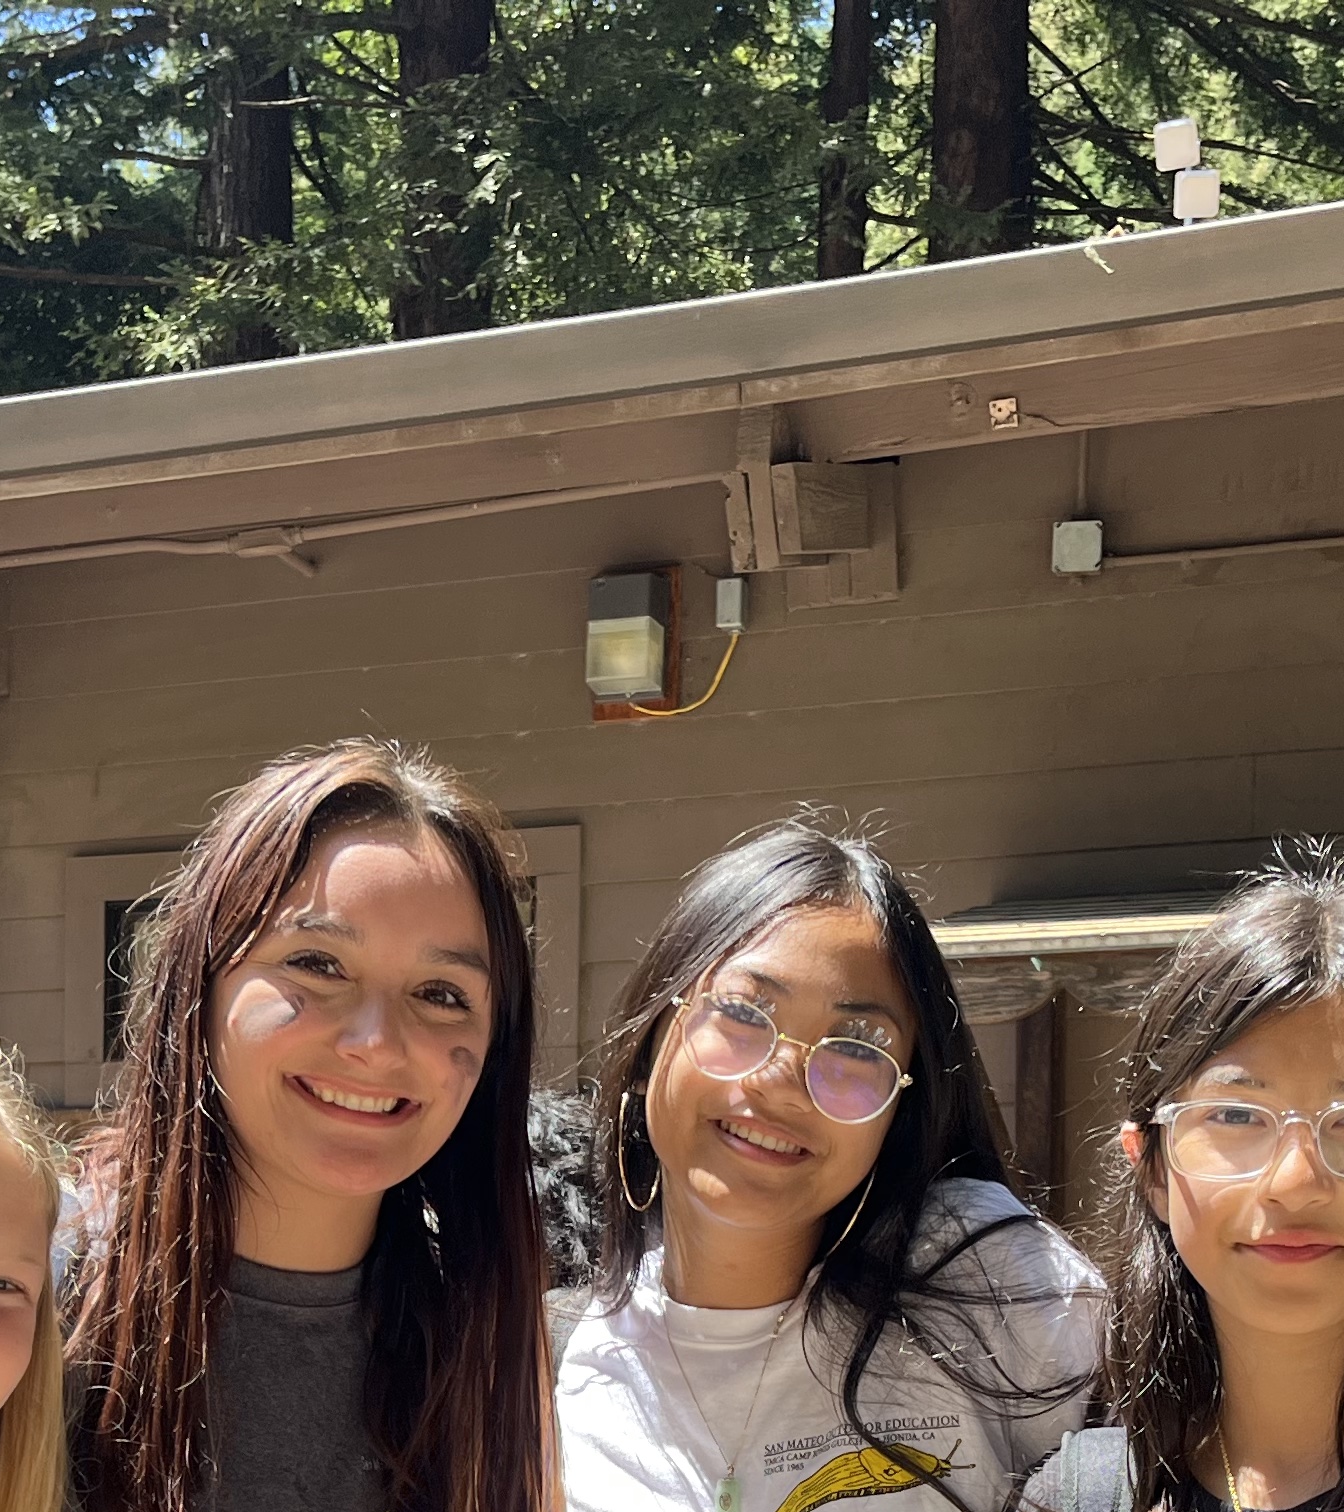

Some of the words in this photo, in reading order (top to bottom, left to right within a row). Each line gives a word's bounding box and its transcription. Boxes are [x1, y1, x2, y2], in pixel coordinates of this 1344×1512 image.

[763, 1440, 785, 1455] SAN
[786, 1434, 824, 1450] MATEO
[825, 1421, 883, 1441] OUTDOR
[885, 1414, 960, 1431] EDUCATION
[786, 1451, 811, 1462] CAMP
[921, 1431, 936, 1441] CA
